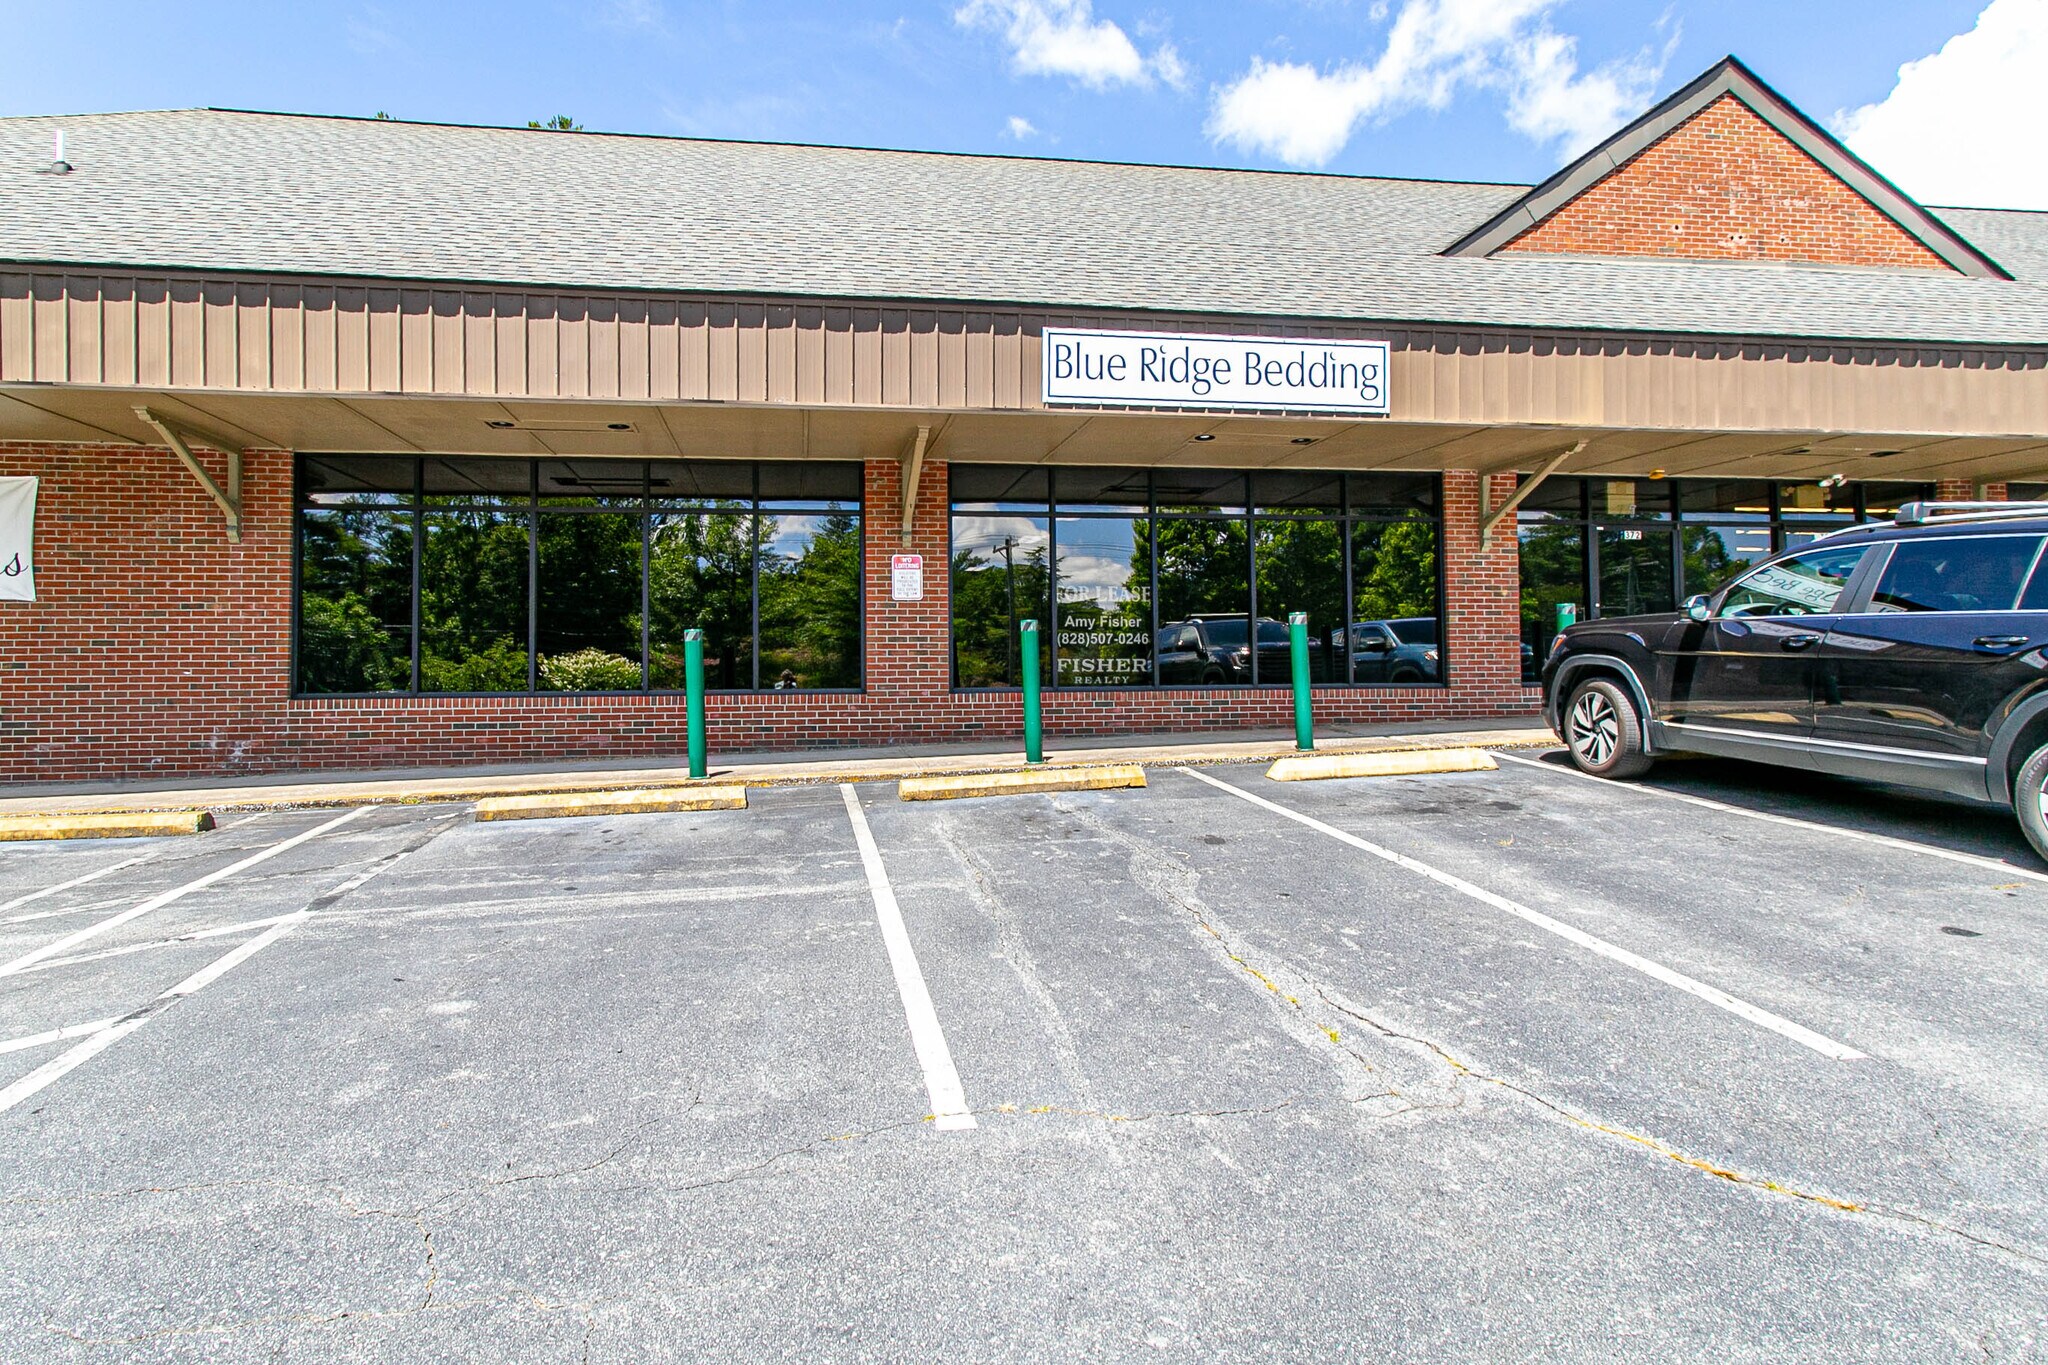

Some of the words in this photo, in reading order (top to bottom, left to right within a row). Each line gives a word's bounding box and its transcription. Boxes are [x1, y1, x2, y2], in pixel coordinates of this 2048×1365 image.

[1055, 342, 1127, 381] Blue
[1140, 344, 1231, 396] Ridge
[1245, 351, 1379, 401] Bedding
[1625, 531, 1640, 539] 372
[1057, 585, 1089, 602] FOR
[1096, 585, 1151, 602] LEASE
[1064, 615, 1096, 630] Amy
[1100, 615, 1142, 628] Fisher
[1057, 633, 1149, 647] (828)507-0246
[1057, 658, 1148, 673] FISHER
[1074, 676, 1130, 684] REALTY
